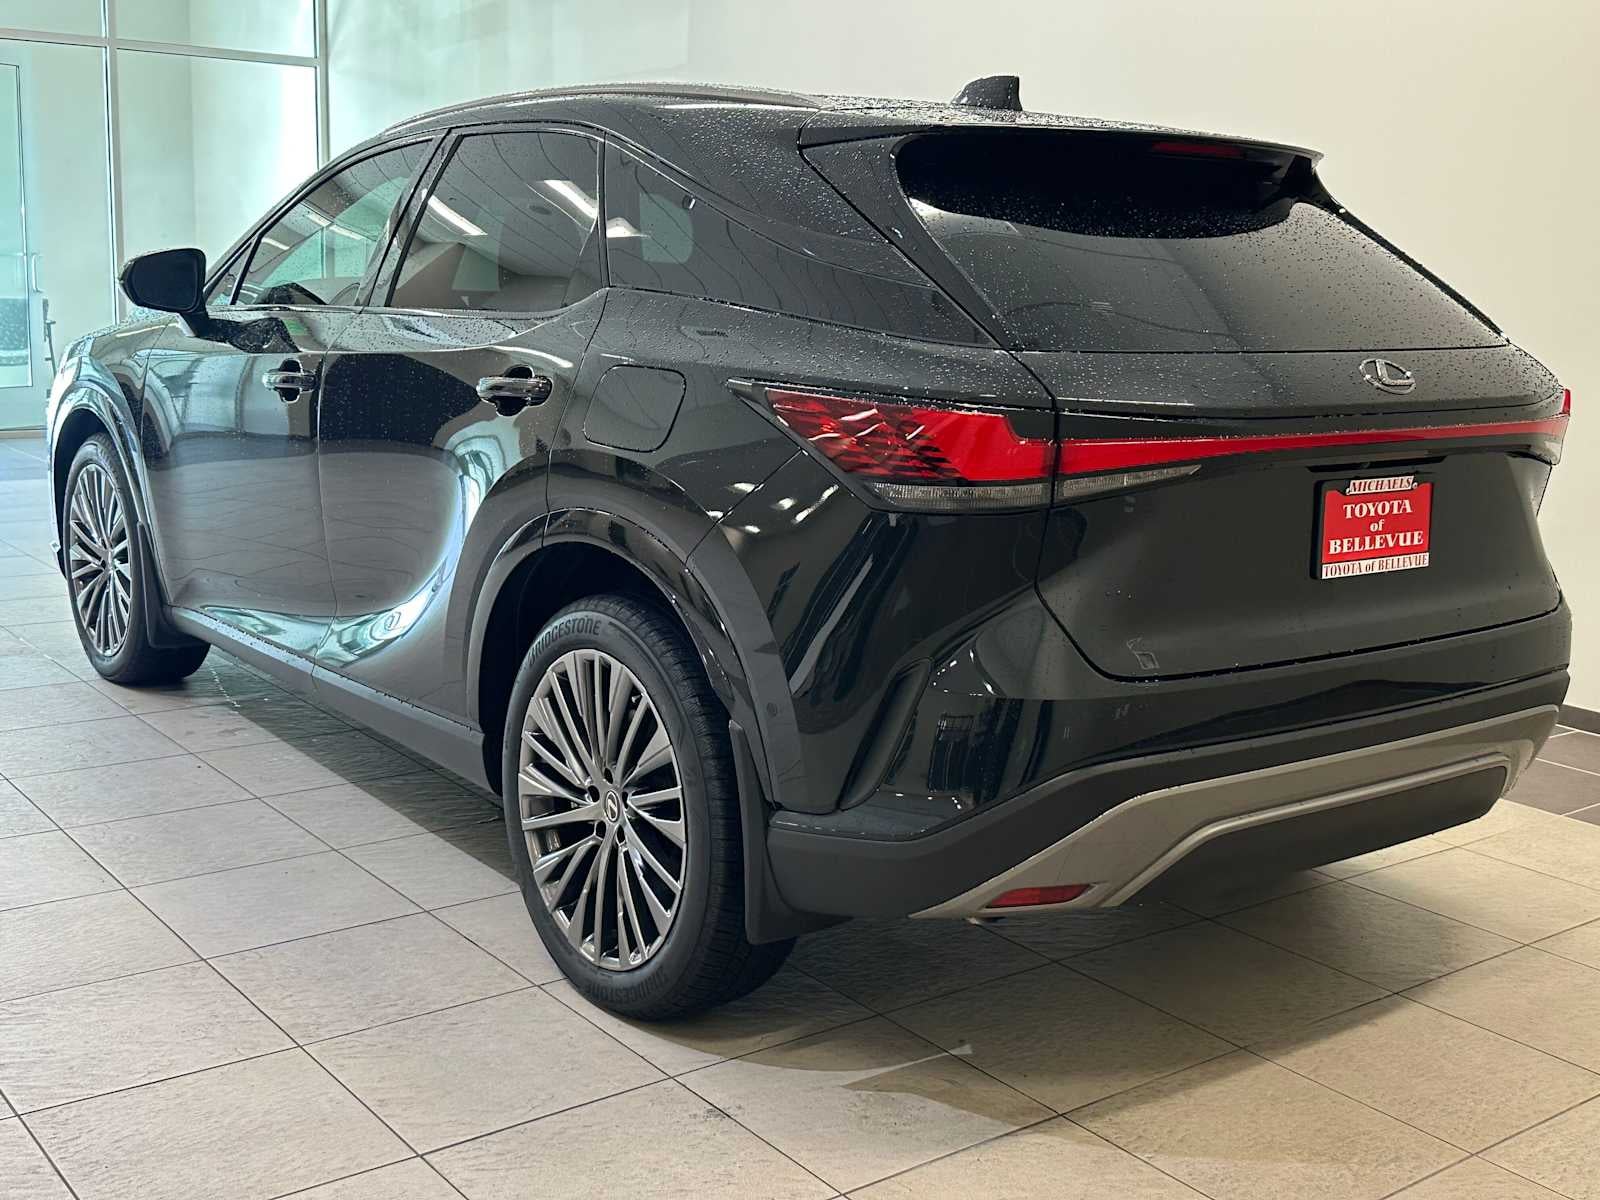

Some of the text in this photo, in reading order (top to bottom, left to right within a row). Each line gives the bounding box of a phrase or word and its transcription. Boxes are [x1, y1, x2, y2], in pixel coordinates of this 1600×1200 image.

[1351, 477, 1411, 492] MICHAELS
[1343, 499, 1412, 518] TOYOTA
[1369, 519, 1385, 532] of
[1329, 531, 1423, 554] BELLEVUE
[1324, 554, 1427, 577] TOYOTA of BELLEVUE
